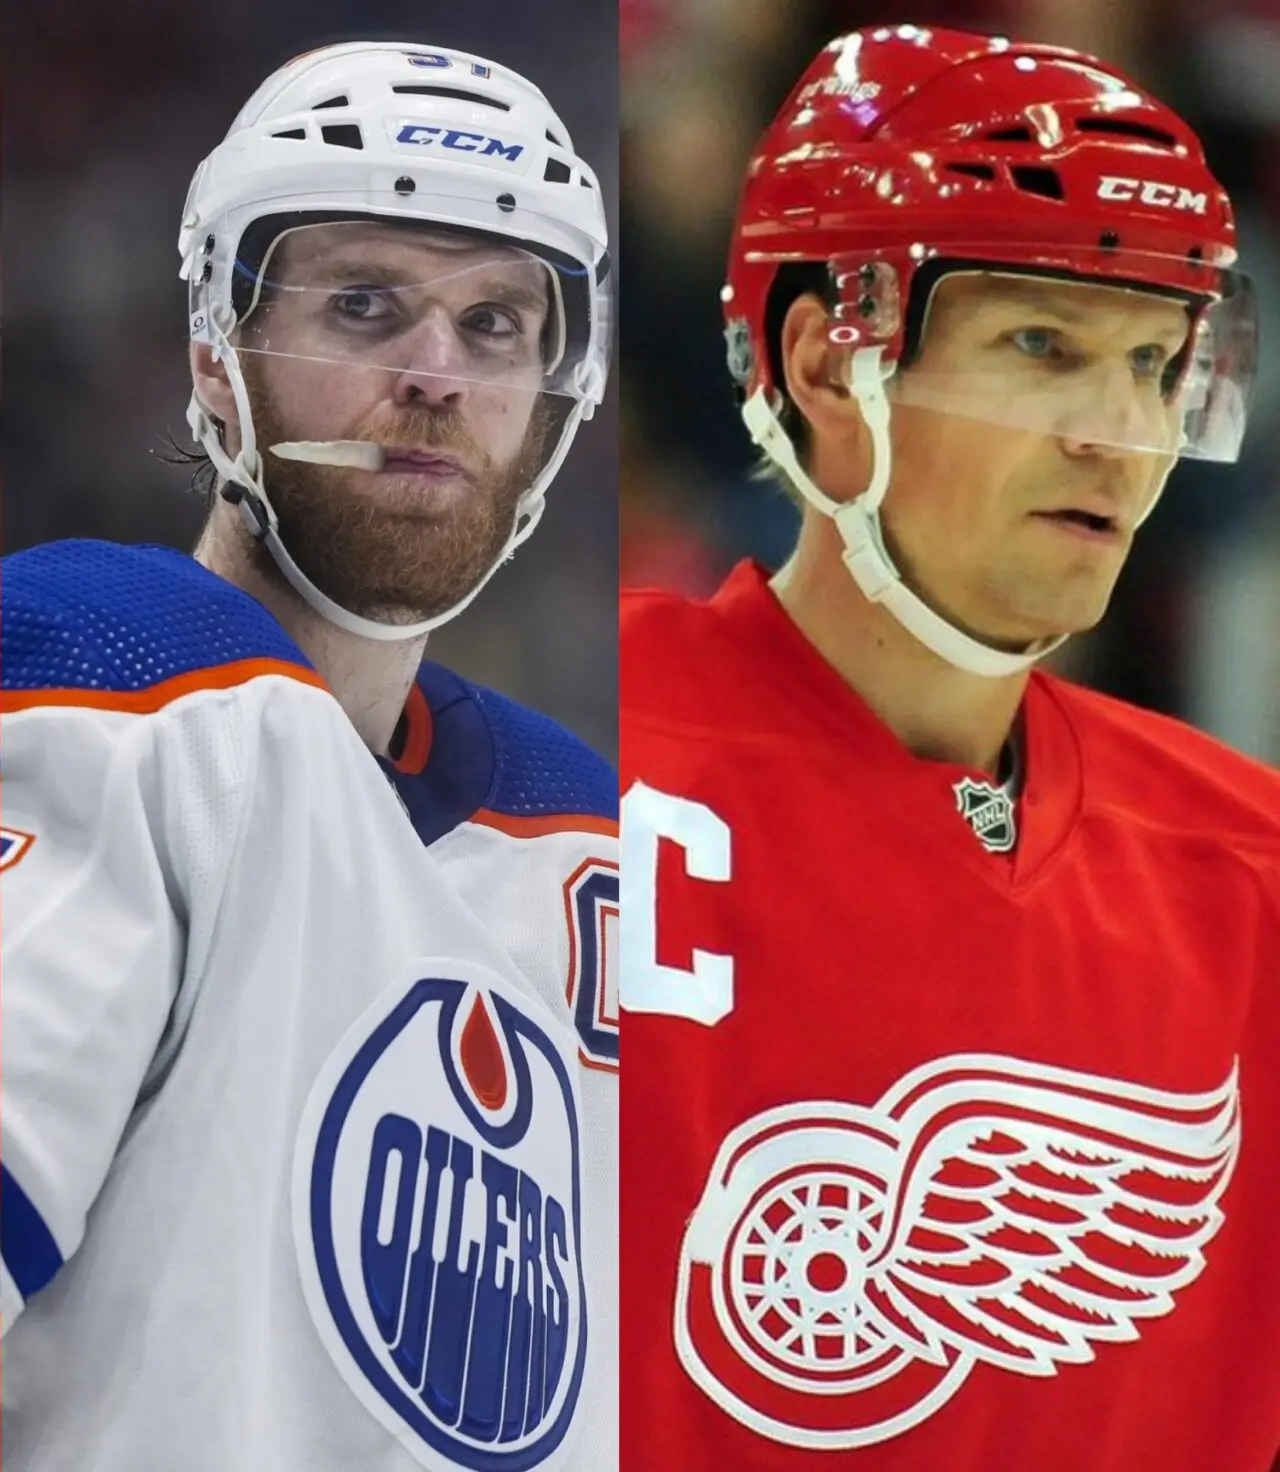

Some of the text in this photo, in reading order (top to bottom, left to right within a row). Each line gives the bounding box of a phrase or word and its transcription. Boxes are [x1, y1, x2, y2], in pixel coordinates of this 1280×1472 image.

[396, 125, 524, 162] CCM
[1097, 175, 1207, 215] CCM
[972, 801, 1006, 831] NHL
[619, 778, 734, 1026] C
[360, 1111, 569, 1445] OILERS
